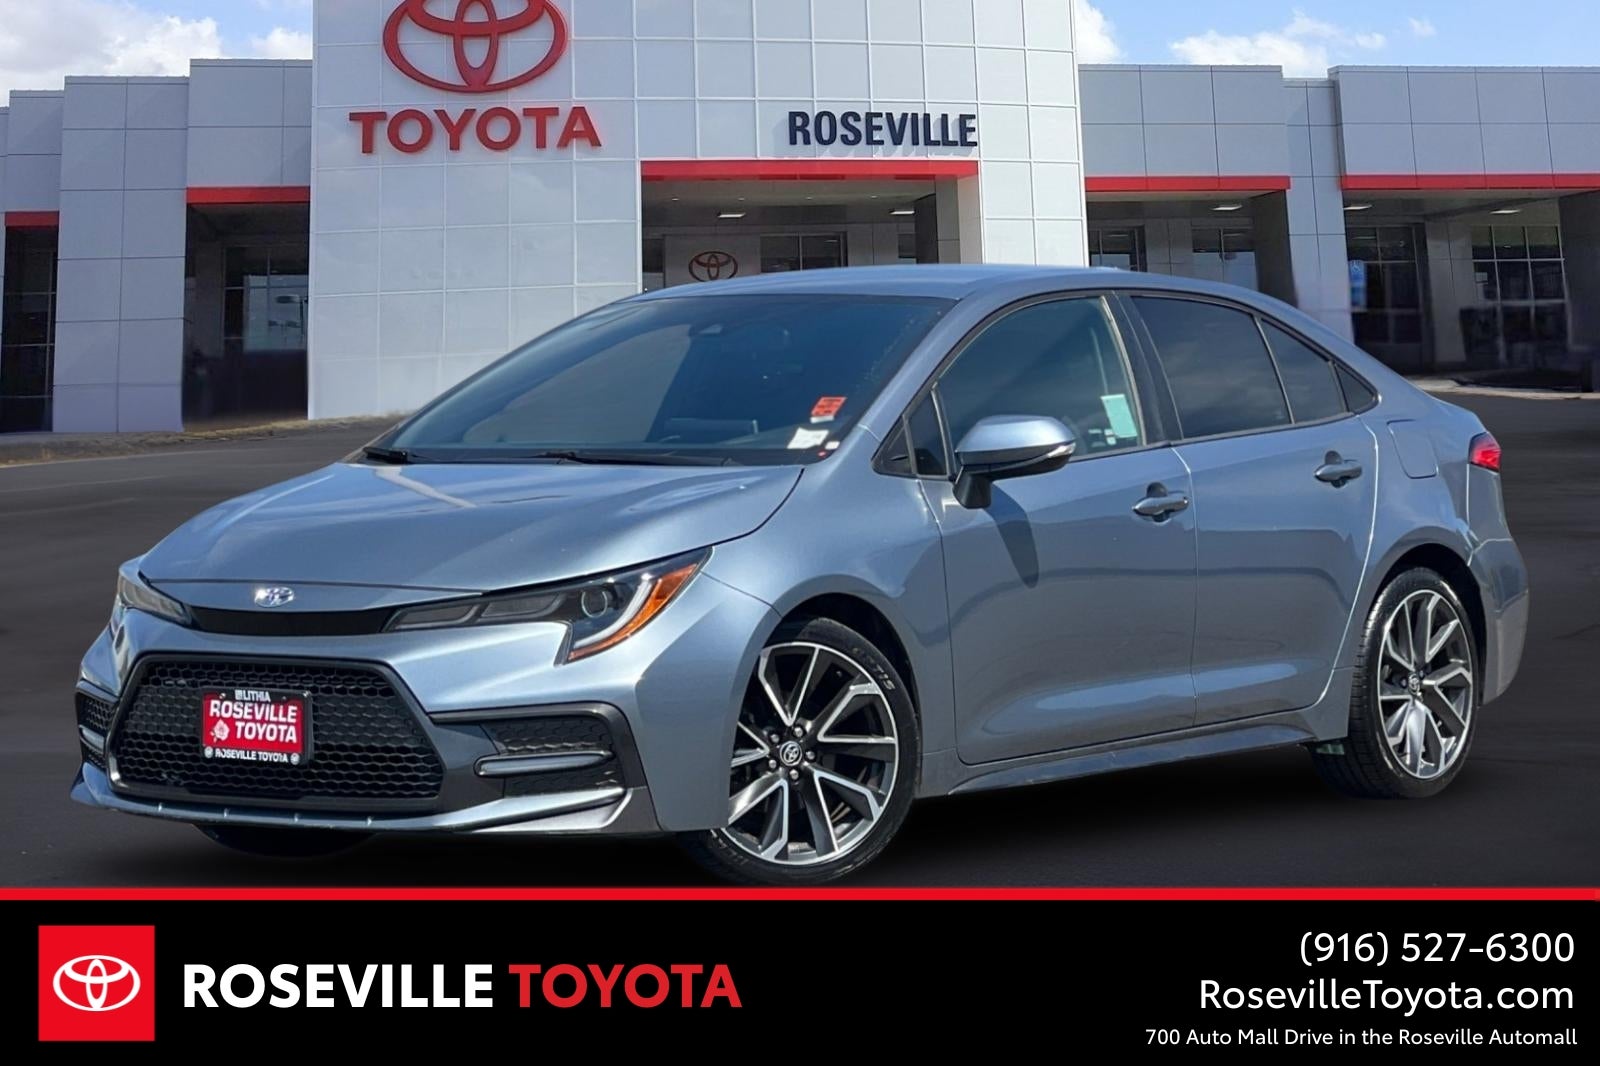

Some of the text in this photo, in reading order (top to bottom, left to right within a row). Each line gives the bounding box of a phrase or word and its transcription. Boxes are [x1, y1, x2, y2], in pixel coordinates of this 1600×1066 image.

[349, 106, 602, 154] TOYOTA
[788, 110, 978, 147] ROSEVILLE
[242, 690, 271, 702] LITHIA
[209, 700, 298, 723] ROSEVILLE
[235, 721, 298, 743] TOYOTA
[215, 748, 289, 763] ROSEVILLE TOYOTA
